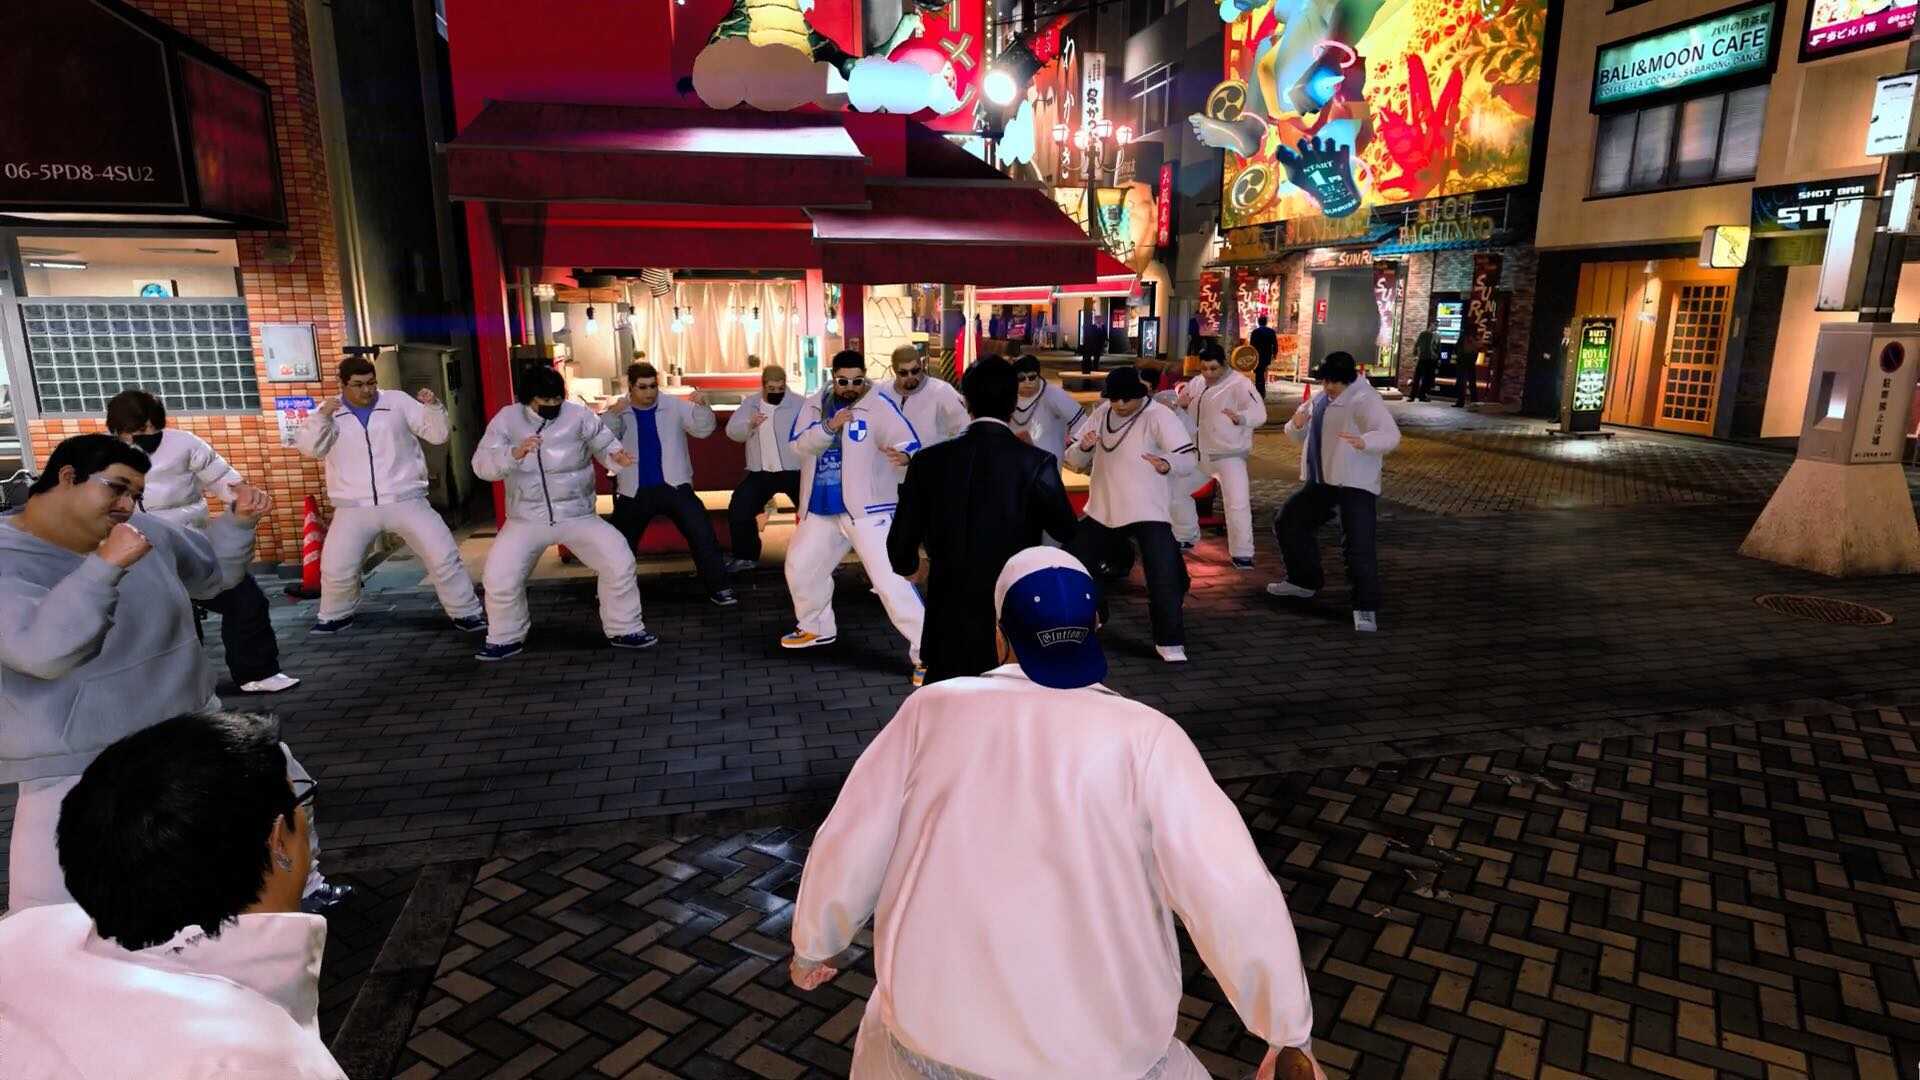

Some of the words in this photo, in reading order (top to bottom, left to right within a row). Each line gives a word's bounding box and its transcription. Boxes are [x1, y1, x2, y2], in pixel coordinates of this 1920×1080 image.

[1599, 44, 1705, 85] BALI&MOON
[1712, 28, 1767, 57] CAFE
[4, 162, 155, 182] 06-5PD8-4SU2
[1798, 188, 1832, 200] SHOT
[1837, 185, 1865, 196] BAR
[1339, 249, 1373, 266] SUNRI
